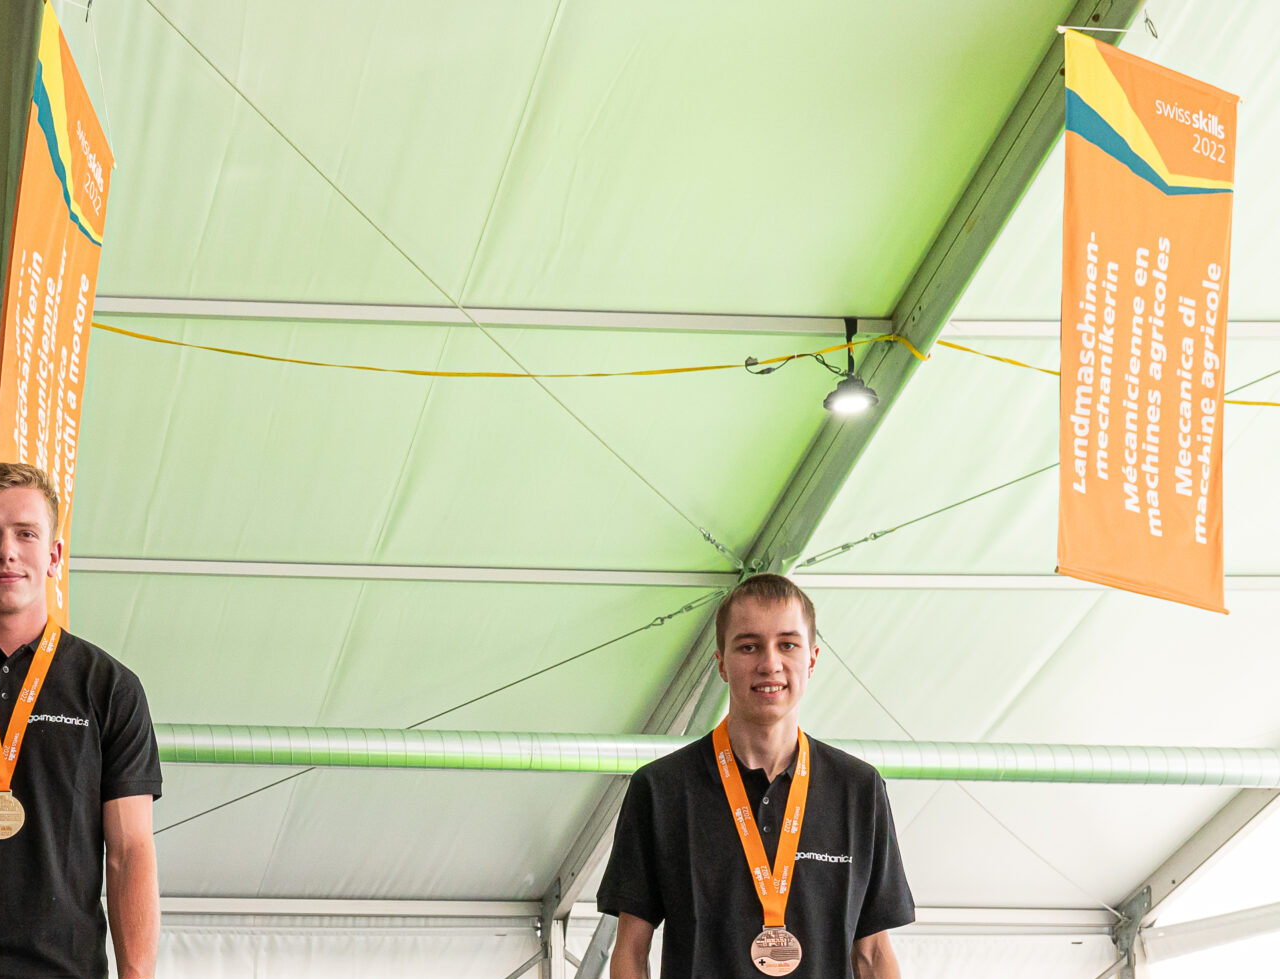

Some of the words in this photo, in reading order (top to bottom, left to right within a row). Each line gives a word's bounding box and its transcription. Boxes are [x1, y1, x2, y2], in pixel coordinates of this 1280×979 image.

[1191, 133, 1226, 164] 2022
[69, 272, 90, 385] motore
[1070, 231, 1099, 494] Landmaschinen-
[1096, 261, 1119, 480] mechanikerin
[1121, 296, 1145, 513] Mécanicienne
[1135, 247, 1150, 287] en
[1149, 236, 1170, 380] agricoles
[1178, 296, 1196, 327] di
[1200, 263, 1221, 388] agricole
[67, 389, 77, 410] a
[1141, 389, 1163, 537] machines
[1174, 337, 1194, 496] Meccanica
[1194, 397, 1216, 544] macchine
